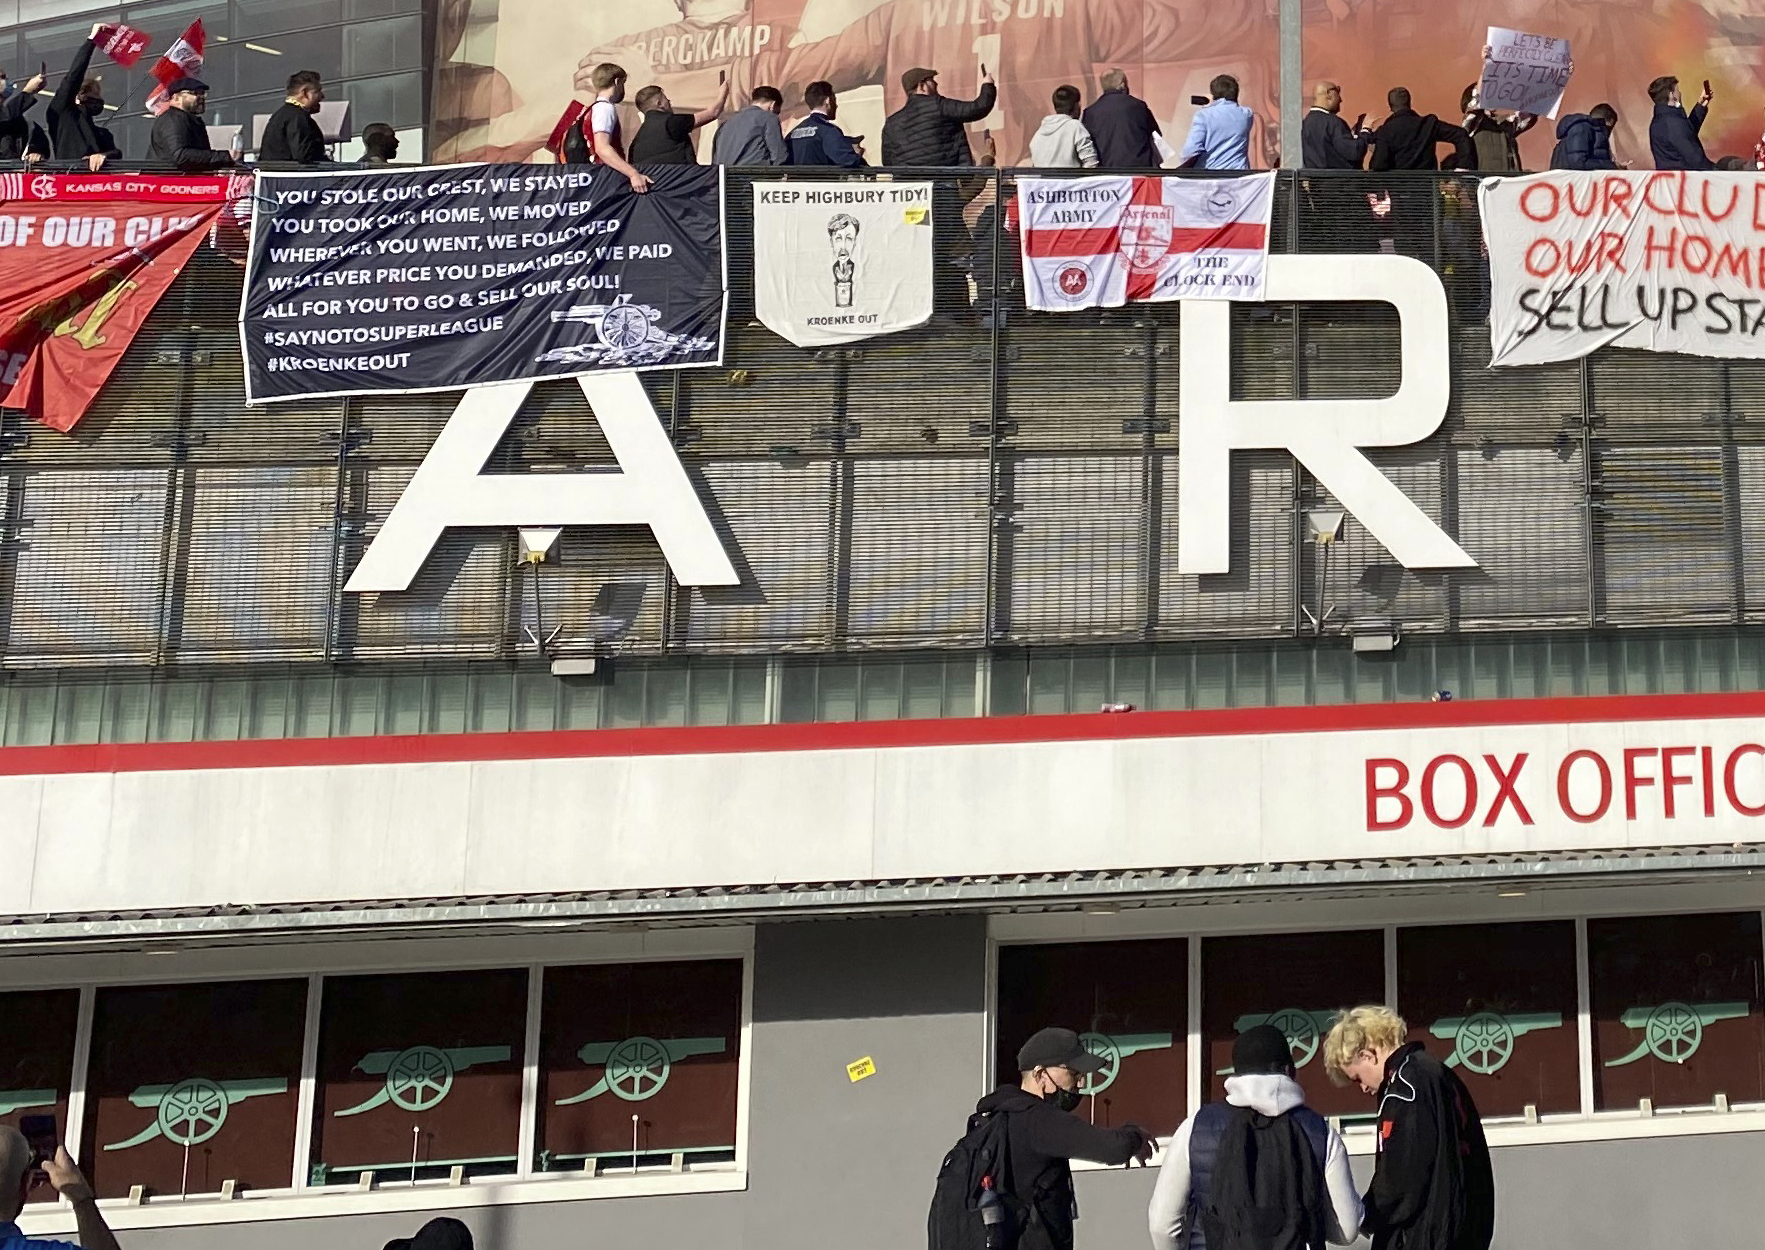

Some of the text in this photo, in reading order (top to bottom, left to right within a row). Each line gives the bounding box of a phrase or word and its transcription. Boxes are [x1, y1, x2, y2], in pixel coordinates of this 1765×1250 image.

[1487, 60, 1570, 88] ITS TIME
[65, 182, 220, 195] KANSAS CITY GOONERS
[276, 172, 593, 205] YOU STOLE OUR CREST, WE STAYED
[760, 188, 928, 204] KEEP HIGHBURY TIDY!
[1027, 188, 1121, 205] ASHBURTON
[1518, 177, 1632, 224] OUR
[0, 215, 37, 248] OF
[42, 216, 117, 248] OUR
[272, 200, 592, 234] YOU TOOK OUR HOME, WE MOVED
[1050, 209, 1097, 224] ARMY
[270, 218, 621, 263] WHEREVER YOU WENT, WE FOLLOWED
[1524, 230, 1628, 279] OUR
[267, 243, 673, 291] WHATEVER PRICE YOU DEMANDED, WE PAID
[1193, 256, 1229, 269] THE
[262, 274, 620, 319] ALL FOR YOU TO GO & SELL OUR SOUL!
[1164, 273, 1256, 288] CLOCK END
[806, 314, 879, 327] KROENKE OUT
[1518, 283, 1631, 339] SELL
[1636, 285, 1698, 330] UP
[263, 315, 504, 346] #SAYNOTOSUPERLEAGUE
[267, 352, 411, 373] #KROENKEOUT
[1365, 753, 1536, 833] BOX
